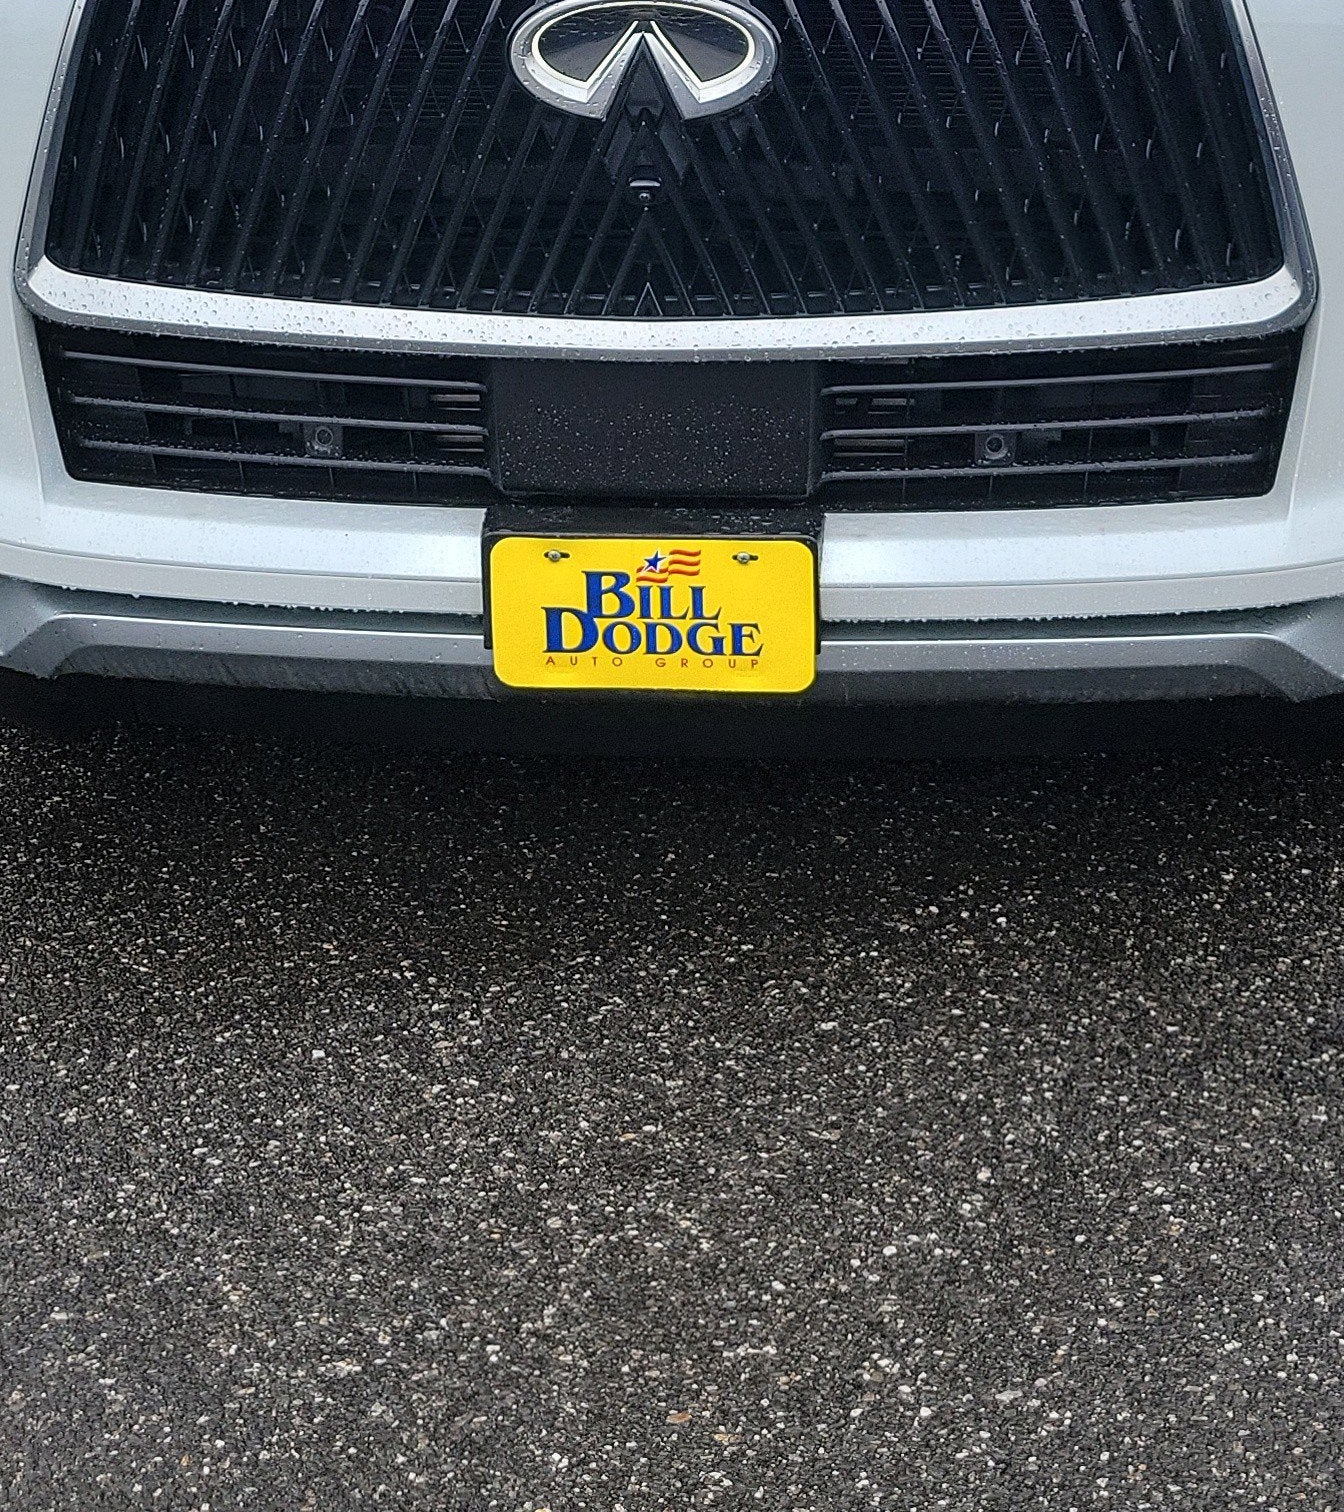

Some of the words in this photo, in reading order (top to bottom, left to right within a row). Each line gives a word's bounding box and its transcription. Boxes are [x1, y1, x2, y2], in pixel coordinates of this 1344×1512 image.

[581, 570, 722, 619] BILL
[541, 606, 764, 656] DODGE
[545, 656, 623, 668] AUTO
[656, 657, 759, 669] GROUP
